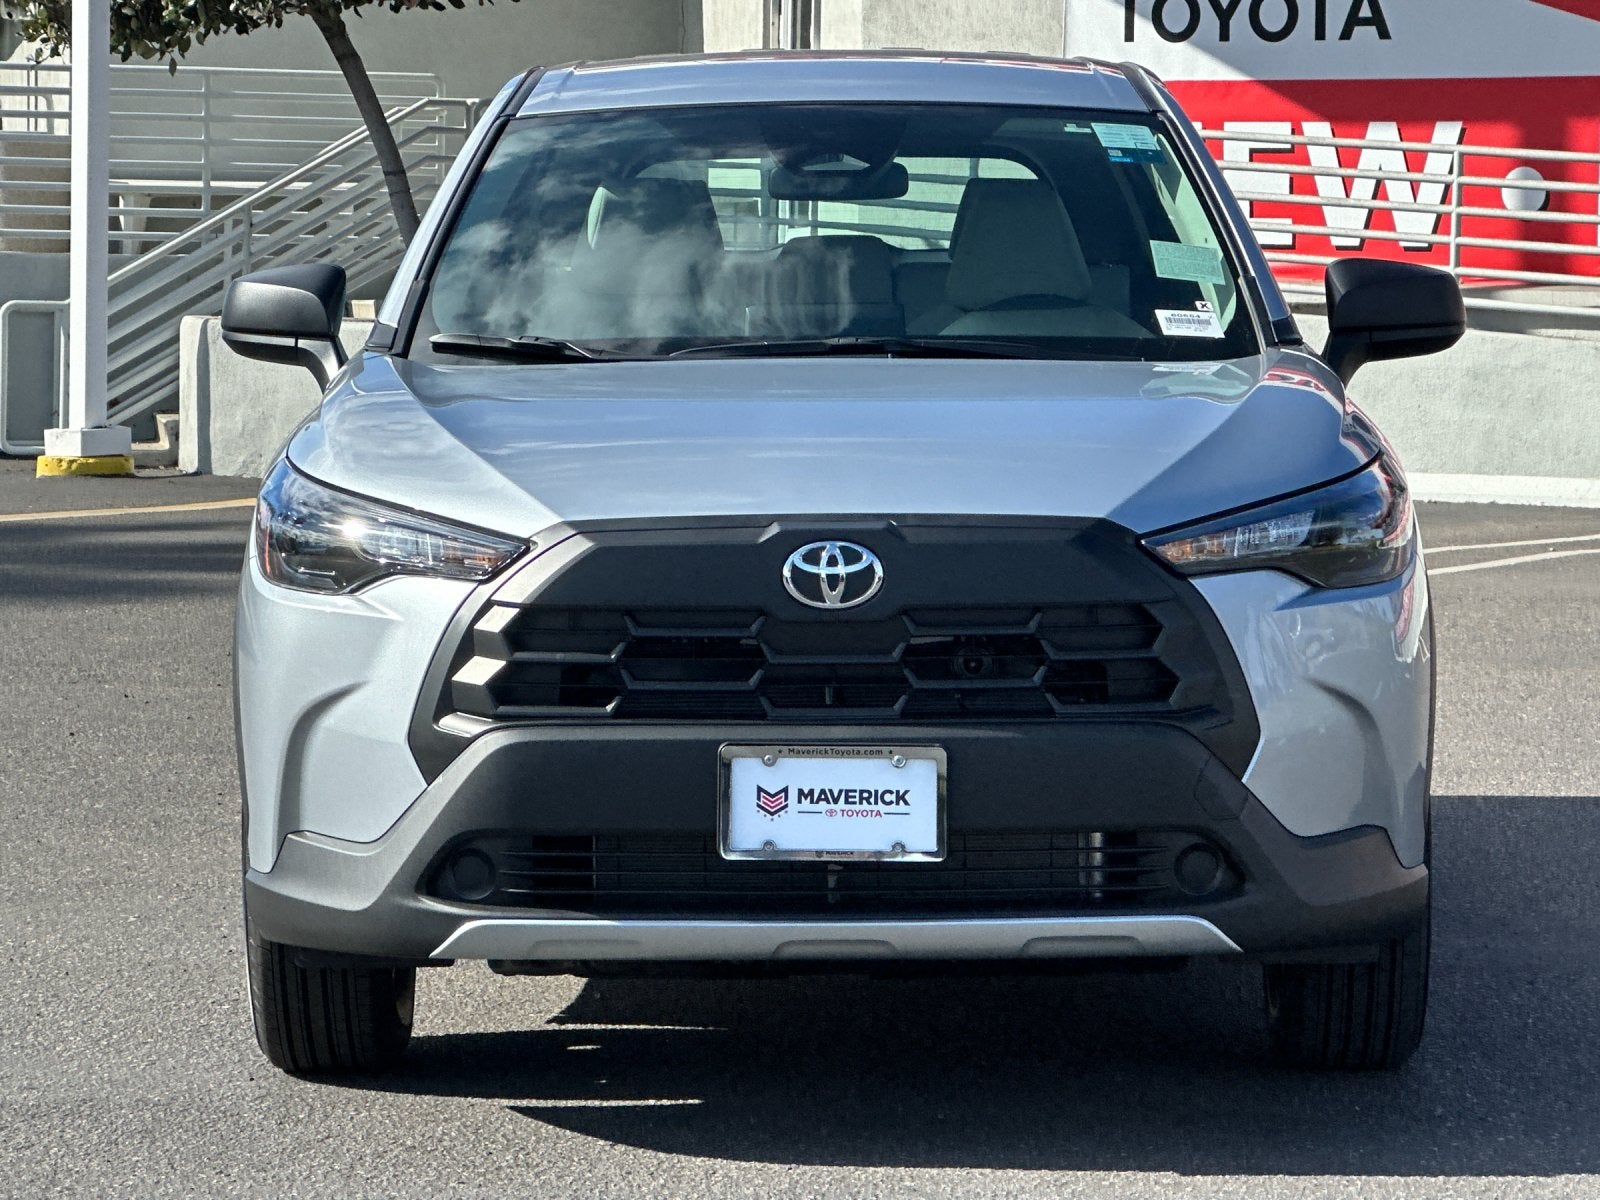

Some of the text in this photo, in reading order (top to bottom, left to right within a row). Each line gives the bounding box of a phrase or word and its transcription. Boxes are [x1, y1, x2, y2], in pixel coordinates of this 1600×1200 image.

[1190, 120, 1465, 249] EW
[788, 748, 883, 757] MaverickToyota.com
[797, 788, 911, 807] MAVERICK
[840, 809, 883, 819] TOYOTA
